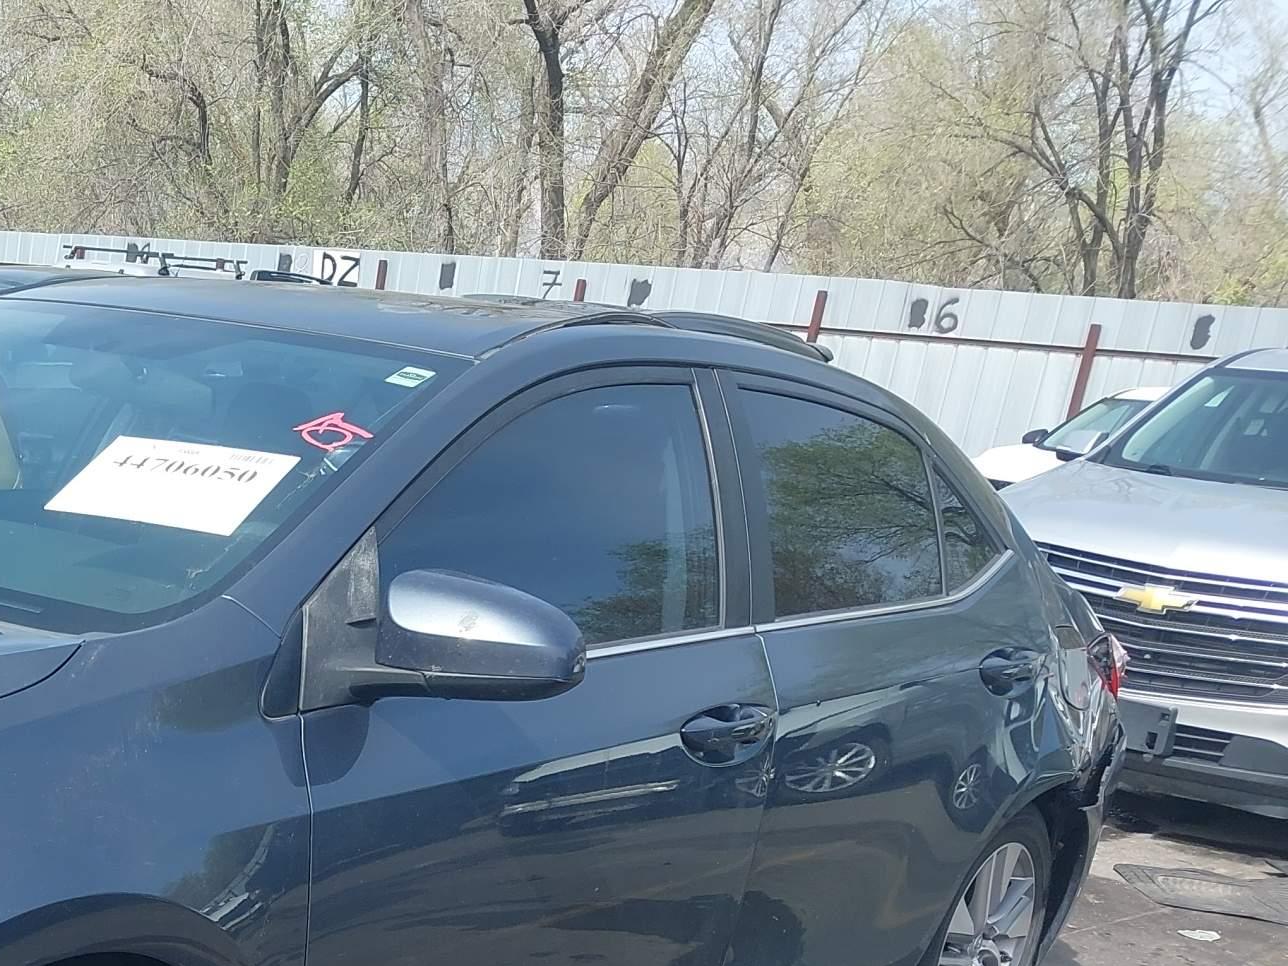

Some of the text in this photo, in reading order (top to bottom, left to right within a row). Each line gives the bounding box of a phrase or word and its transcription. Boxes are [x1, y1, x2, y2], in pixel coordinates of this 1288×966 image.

[542, 270, 562, 299] 7
[935, 298, 960, 334] 6
[113, 454, 258, 483] 44706050
